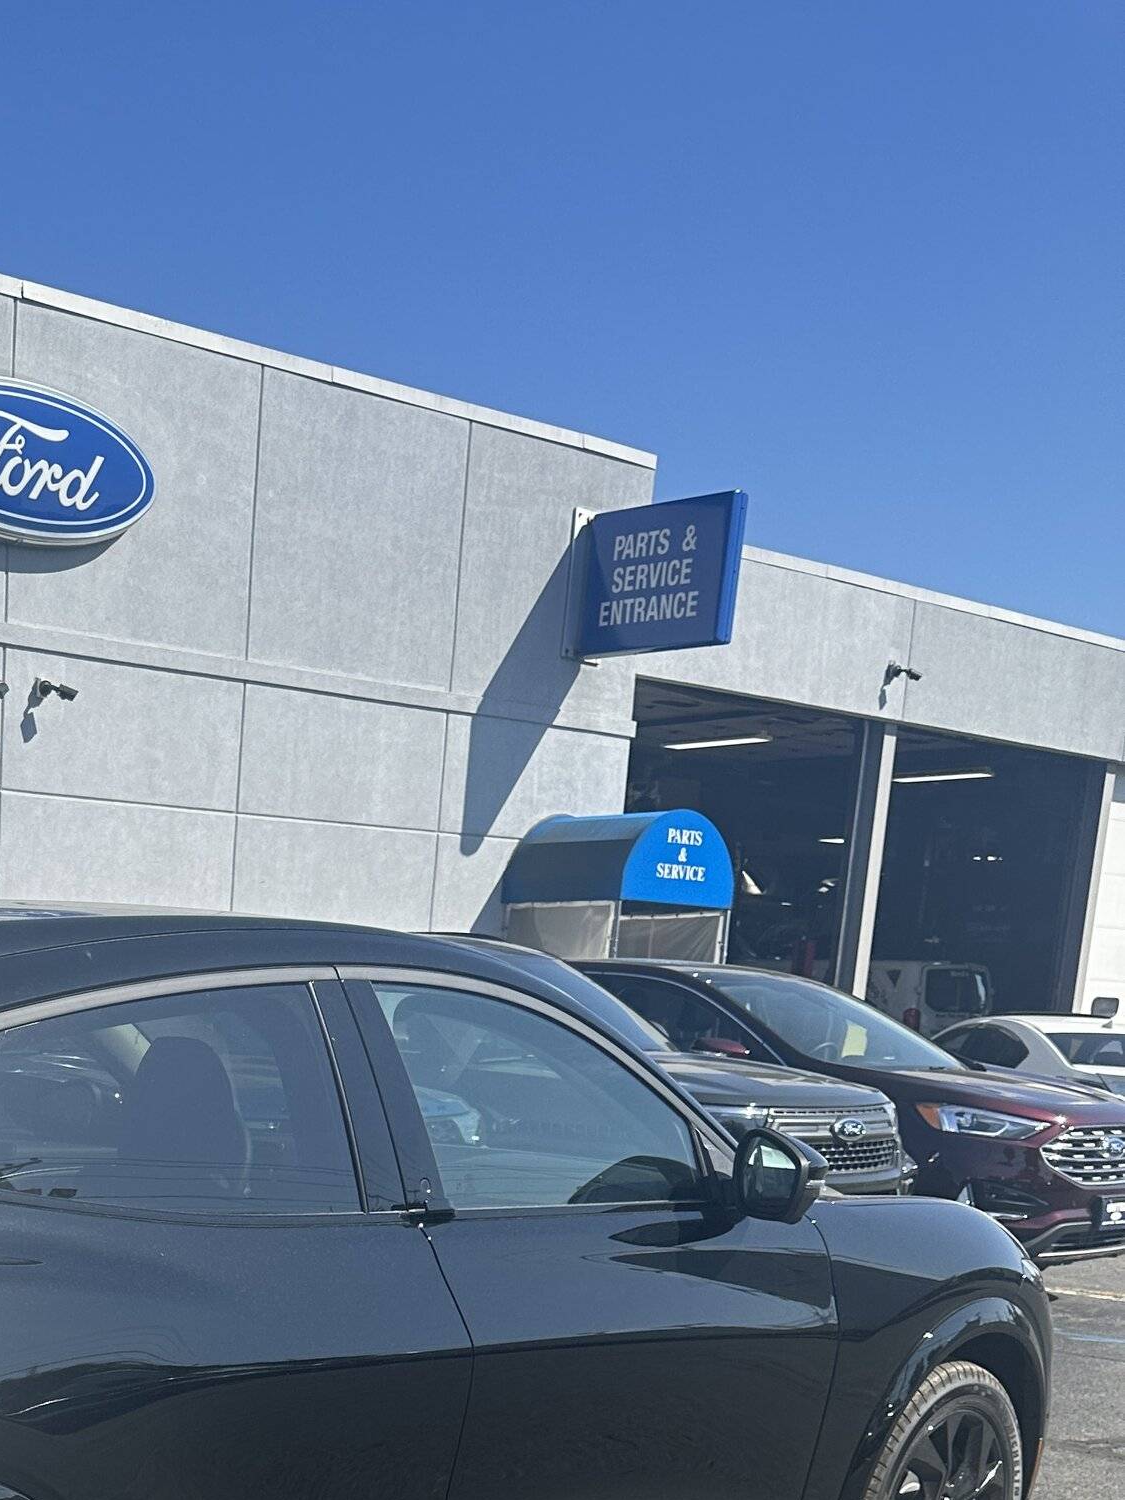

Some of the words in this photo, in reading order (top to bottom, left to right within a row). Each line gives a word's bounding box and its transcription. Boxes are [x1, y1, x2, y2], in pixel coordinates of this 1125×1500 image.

[613, 528, 671, 562] PARTS
[682, 524, 697, 552] &
[611, 558, 693, 594] SERVICE
[598, 591, 700, 627] ENTRANCE
[667, 827, 703, 847] PARTS
[678, 847, 688, 863] &
[656, 862, 707, 882] SERVICE
